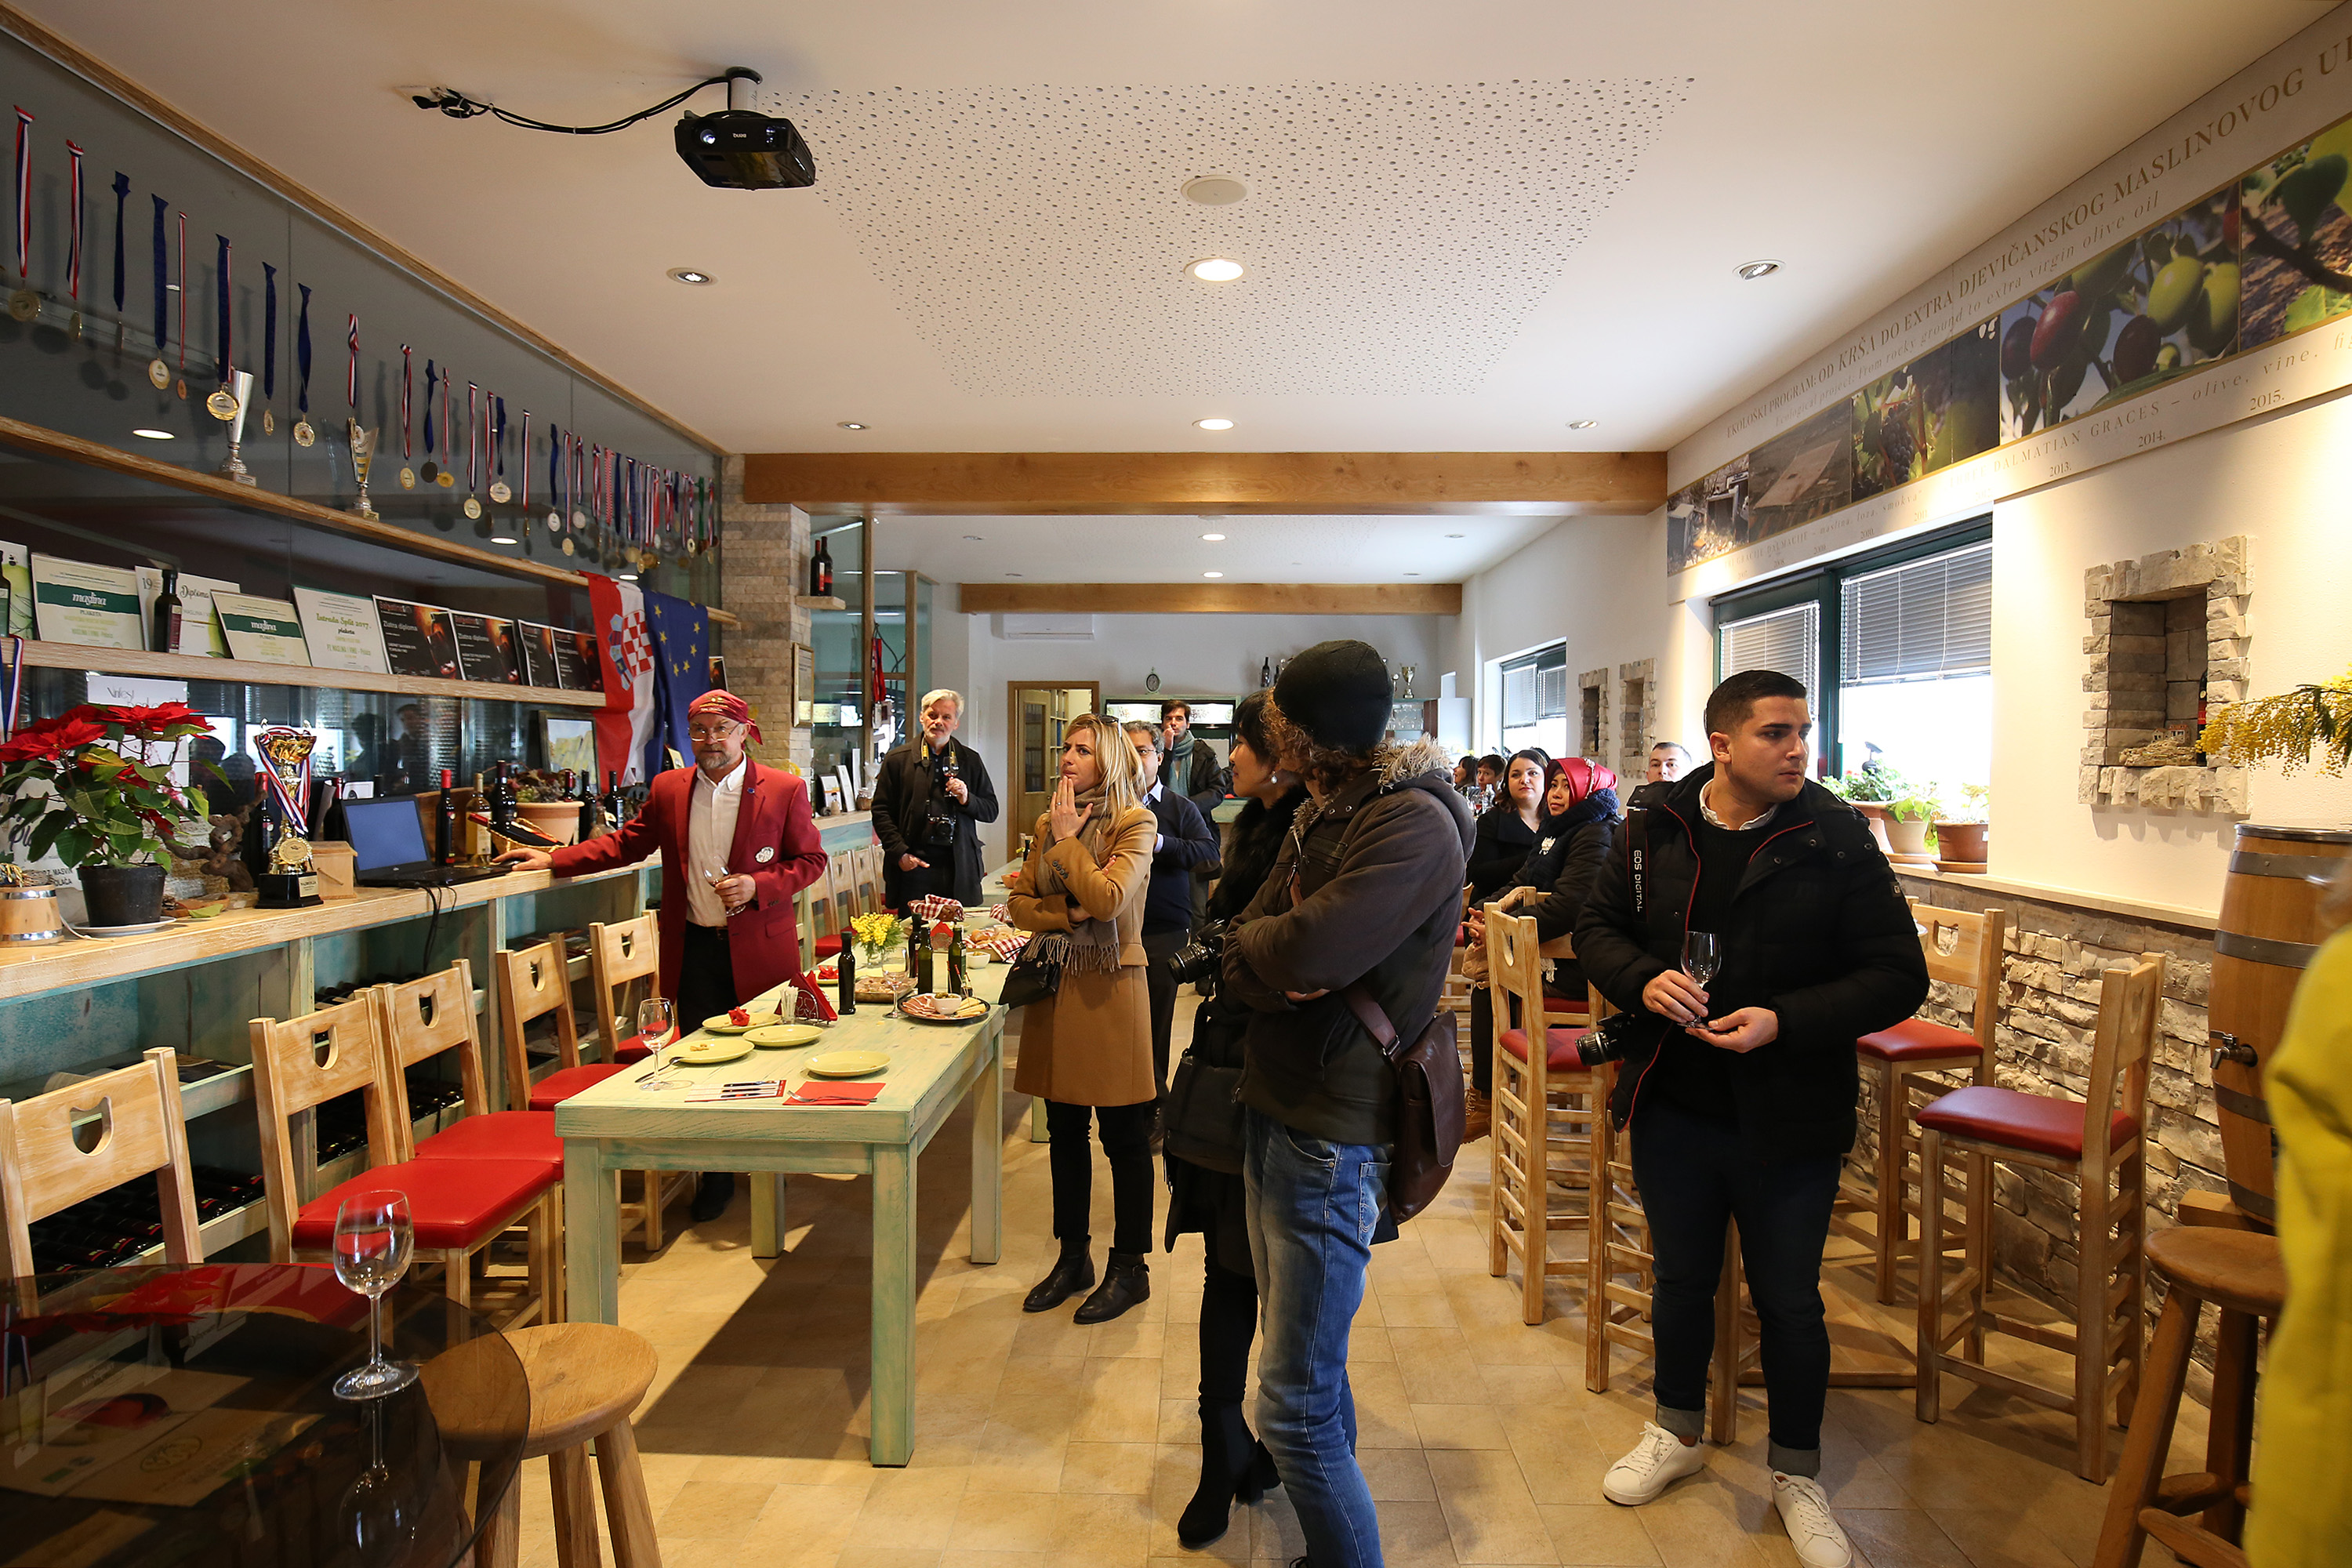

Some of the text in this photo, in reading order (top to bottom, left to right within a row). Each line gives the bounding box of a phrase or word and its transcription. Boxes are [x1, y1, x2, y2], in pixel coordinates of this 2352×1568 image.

[1726, 405, 1768, 439] EKOLOŠKI
[1769, 374, 1817, 413] PROGRAM:
[1819, 363, 1835, 386] OD
[1838, 335, 1877, 373] KRŠA
[1881, 322, 1900, 346] DO
[1904, 290, 1954, 332] EXTRA
[1959, 192, 2105, 299] DJEVIČANSKOG
[2113, 67, 2303, 205] MASLINOVOG
[1886, 338, 1917, 368] rocky
[1920, 310, 1962, 347] ground
[1968, 298, 1982, 317] to
[1987, 278, 2022, 305] extra
[2029, 243, 2074, 279] virgin
[2082, 214, 2125, 249] olive
[2134, 190, 2159, 220] oil
[2249, 389, 2285, 412] 2015.
[1994, 429, 2082, 473] DALMATIAN
[2090, 401, 2160, 438] GRACES
[2049, 461, 2072, 477] 2013.
[2137, 429, 2166, 448] 2014.
[1633, 849, 1643, 913] EOS DIGITAL
